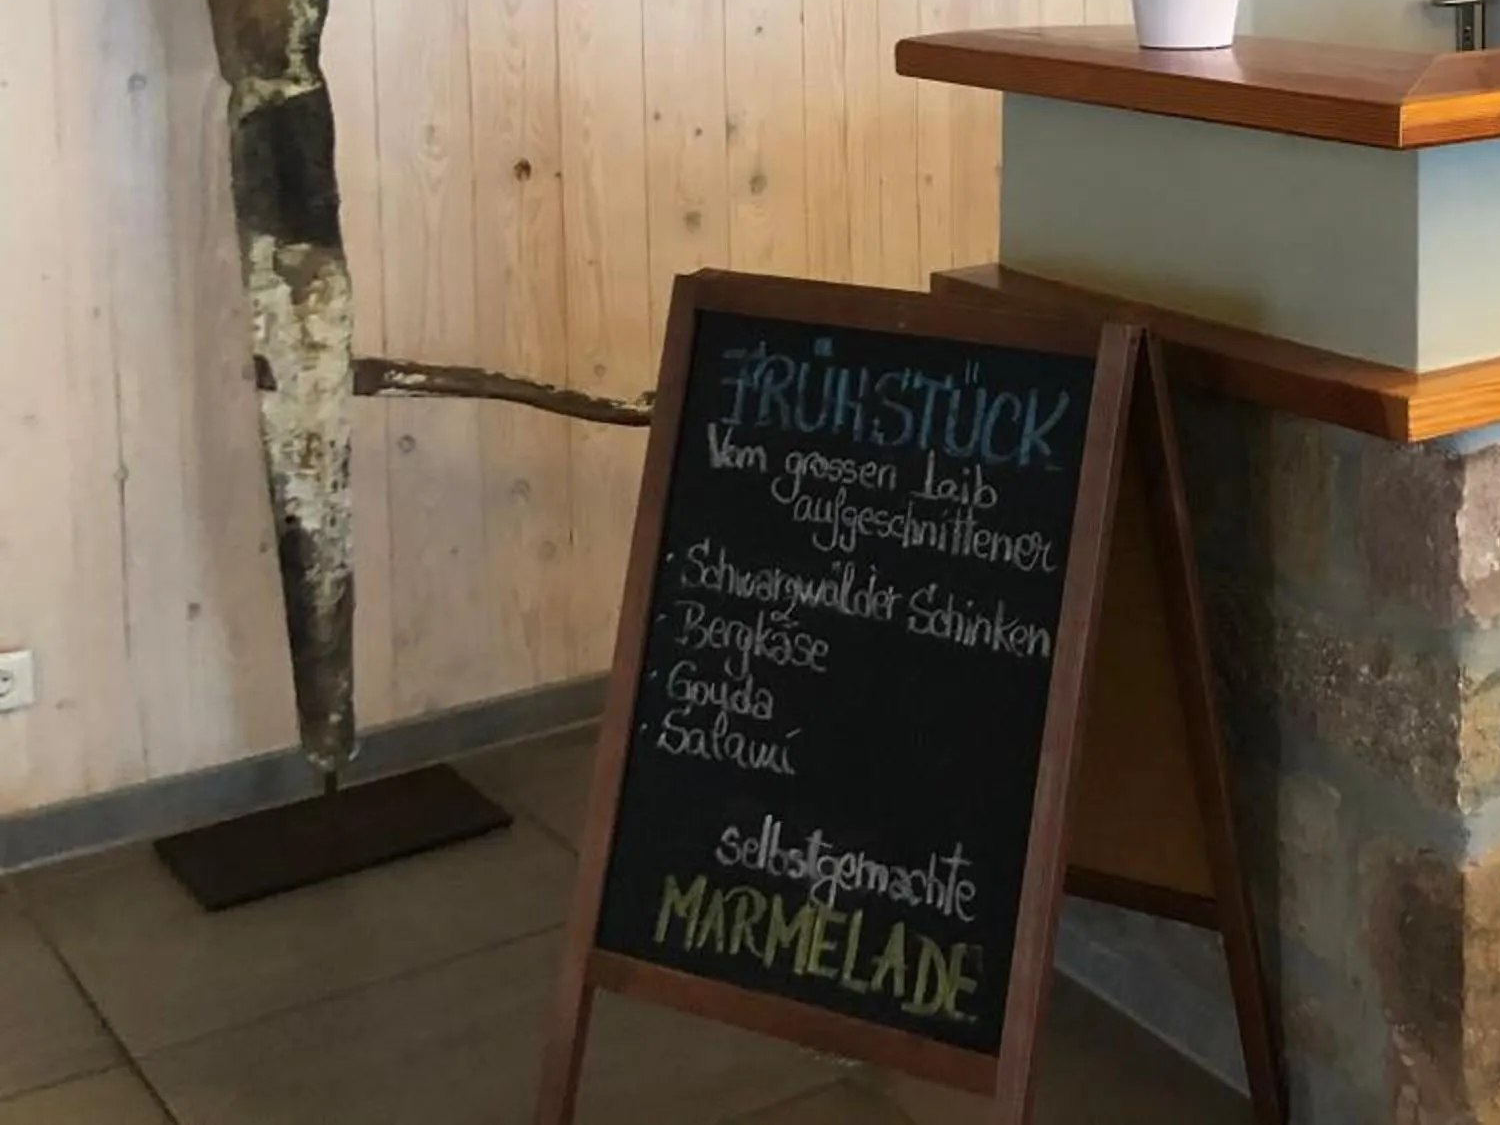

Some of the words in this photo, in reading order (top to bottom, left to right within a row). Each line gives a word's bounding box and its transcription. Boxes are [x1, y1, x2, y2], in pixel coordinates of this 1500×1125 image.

[722, 337, 1070, 467] FRÜHSTÜCK
[706, 422, 767, 470] Vom
[771, 449, 897, 505] grossen
[911, 448, 998, 510] Laib
[793, 487, 1058, 573] aufgeschnittener
[674, 599, 831, 681] Bergkäse
[680, 537, 902, 628] Schwarzwälder
[907, 582, 1052, 658] Schinken
[667, 660, 774, 721] Gouda
[657, 705, 801, 774] Salami
[715, 813, 978, 923] selbstgemachte
[654, 875, 984, 1024] MARMELADE
